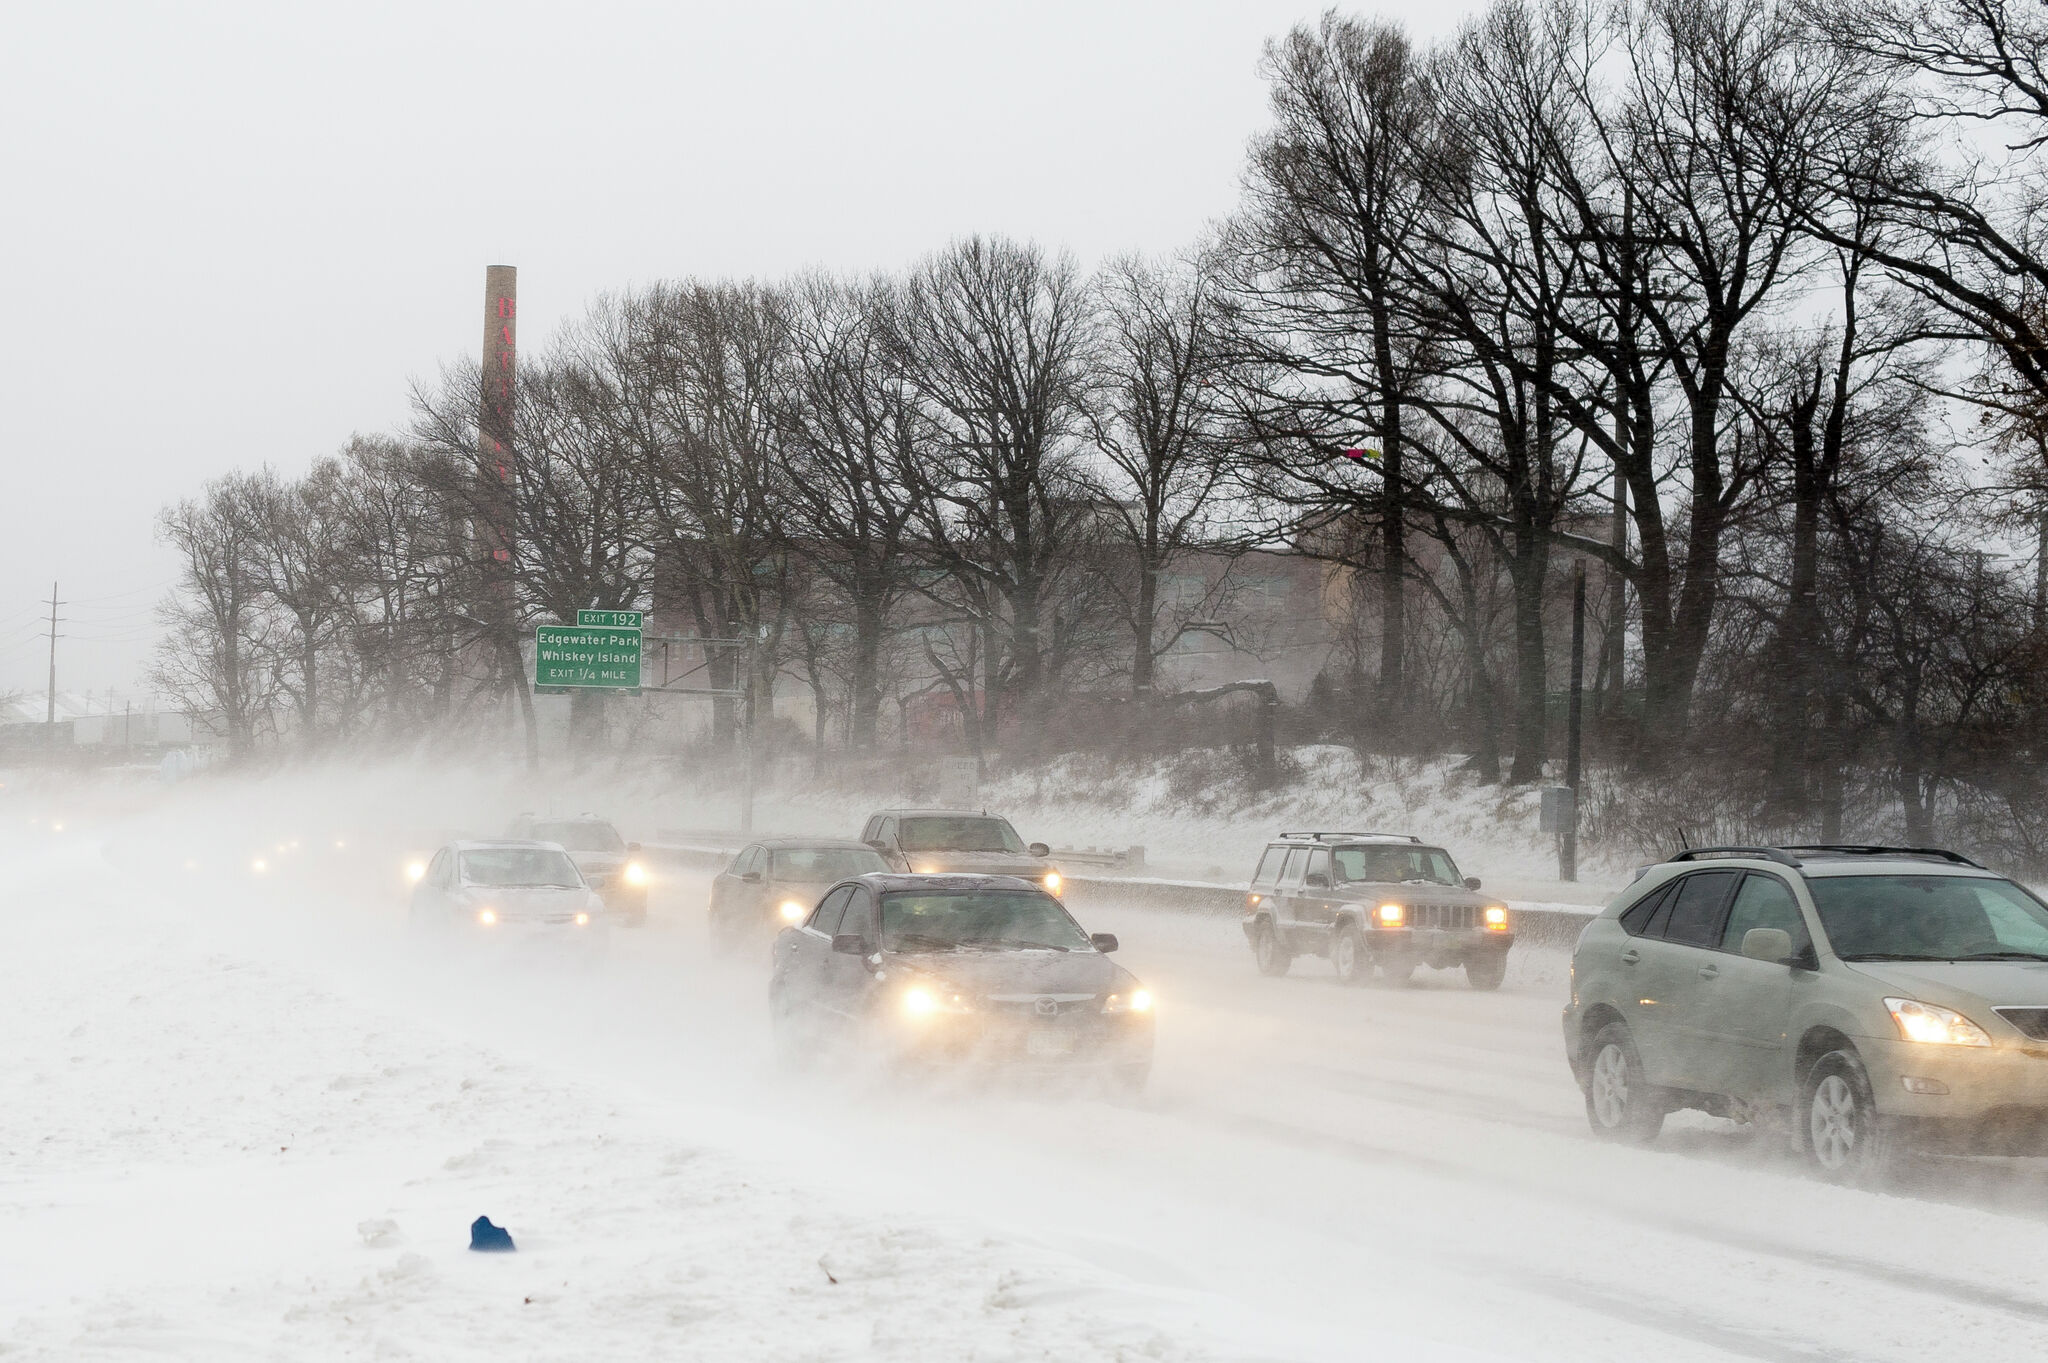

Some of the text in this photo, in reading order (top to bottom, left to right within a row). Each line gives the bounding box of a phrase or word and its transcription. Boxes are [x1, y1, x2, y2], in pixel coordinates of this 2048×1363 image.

[584, 613, 636, 626] EXIT 192
[539, 633, 639, 647] Edgewater Park
[542, 650, 636, 665] Whiskey Island
[550, 668, 626, 680] EXIT 1/4 MILE
